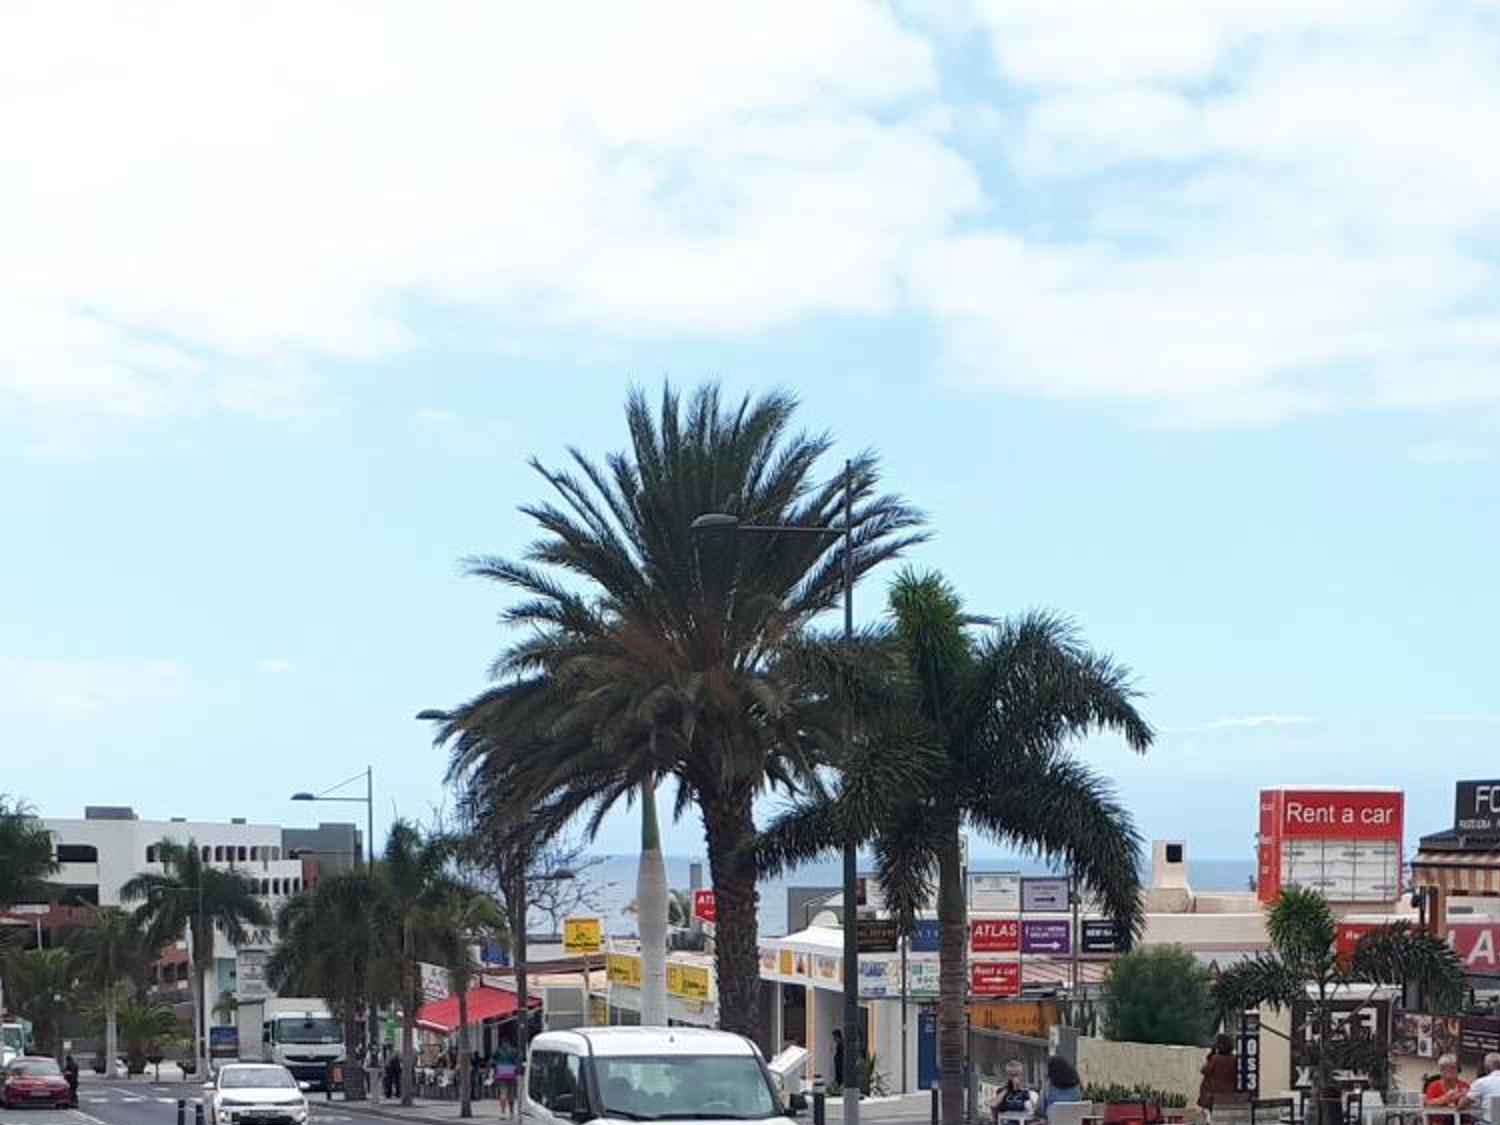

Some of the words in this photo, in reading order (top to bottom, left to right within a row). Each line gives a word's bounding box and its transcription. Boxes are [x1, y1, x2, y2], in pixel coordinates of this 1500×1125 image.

[1286, 802, 1335, 823] Rent
[1341, 808, 1354, 823] a
[1361, 808, 1393, 823] car
[974, 925, 1018, 937] ATLAS
